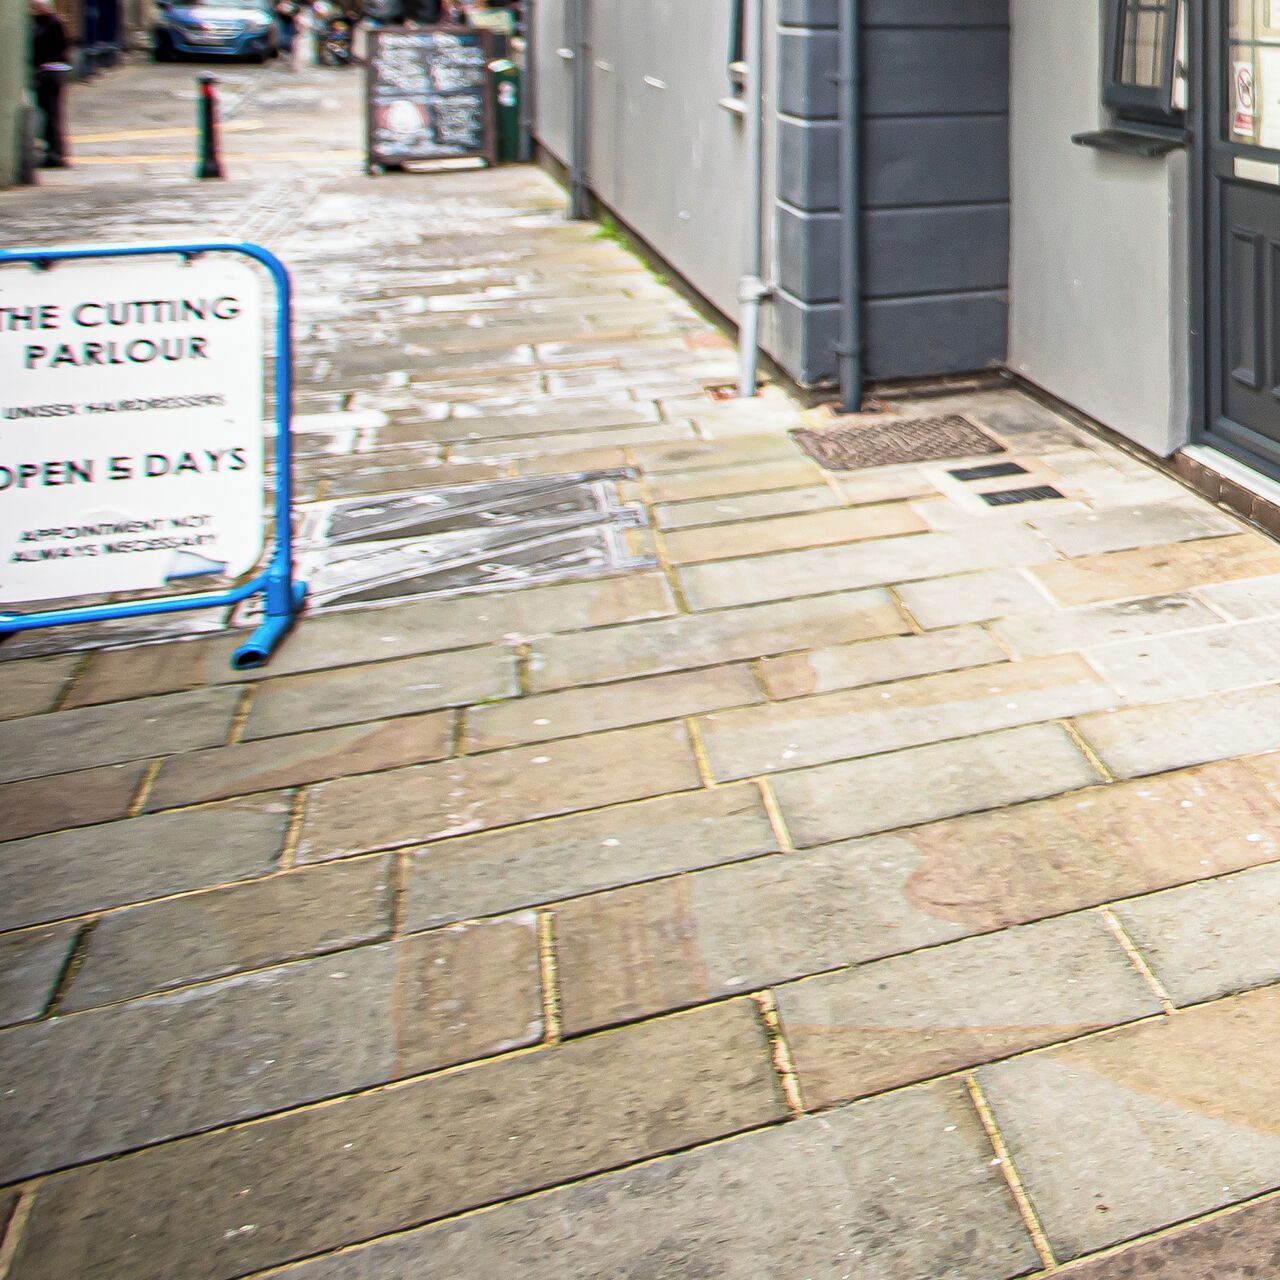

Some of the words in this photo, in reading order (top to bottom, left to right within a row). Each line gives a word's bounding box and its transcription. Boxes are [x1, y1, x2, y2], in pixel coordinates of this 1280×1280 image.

[72, 296, 241, 328] CUTTING
[23, 336, 209, 370] PARLOUR
[107, 456, 134, 481] 5
[144, 447, 248, 479] DAYS
[19, 519, 162, 542] APPOINTMENT
[170, 514, 214, 529] NOT
